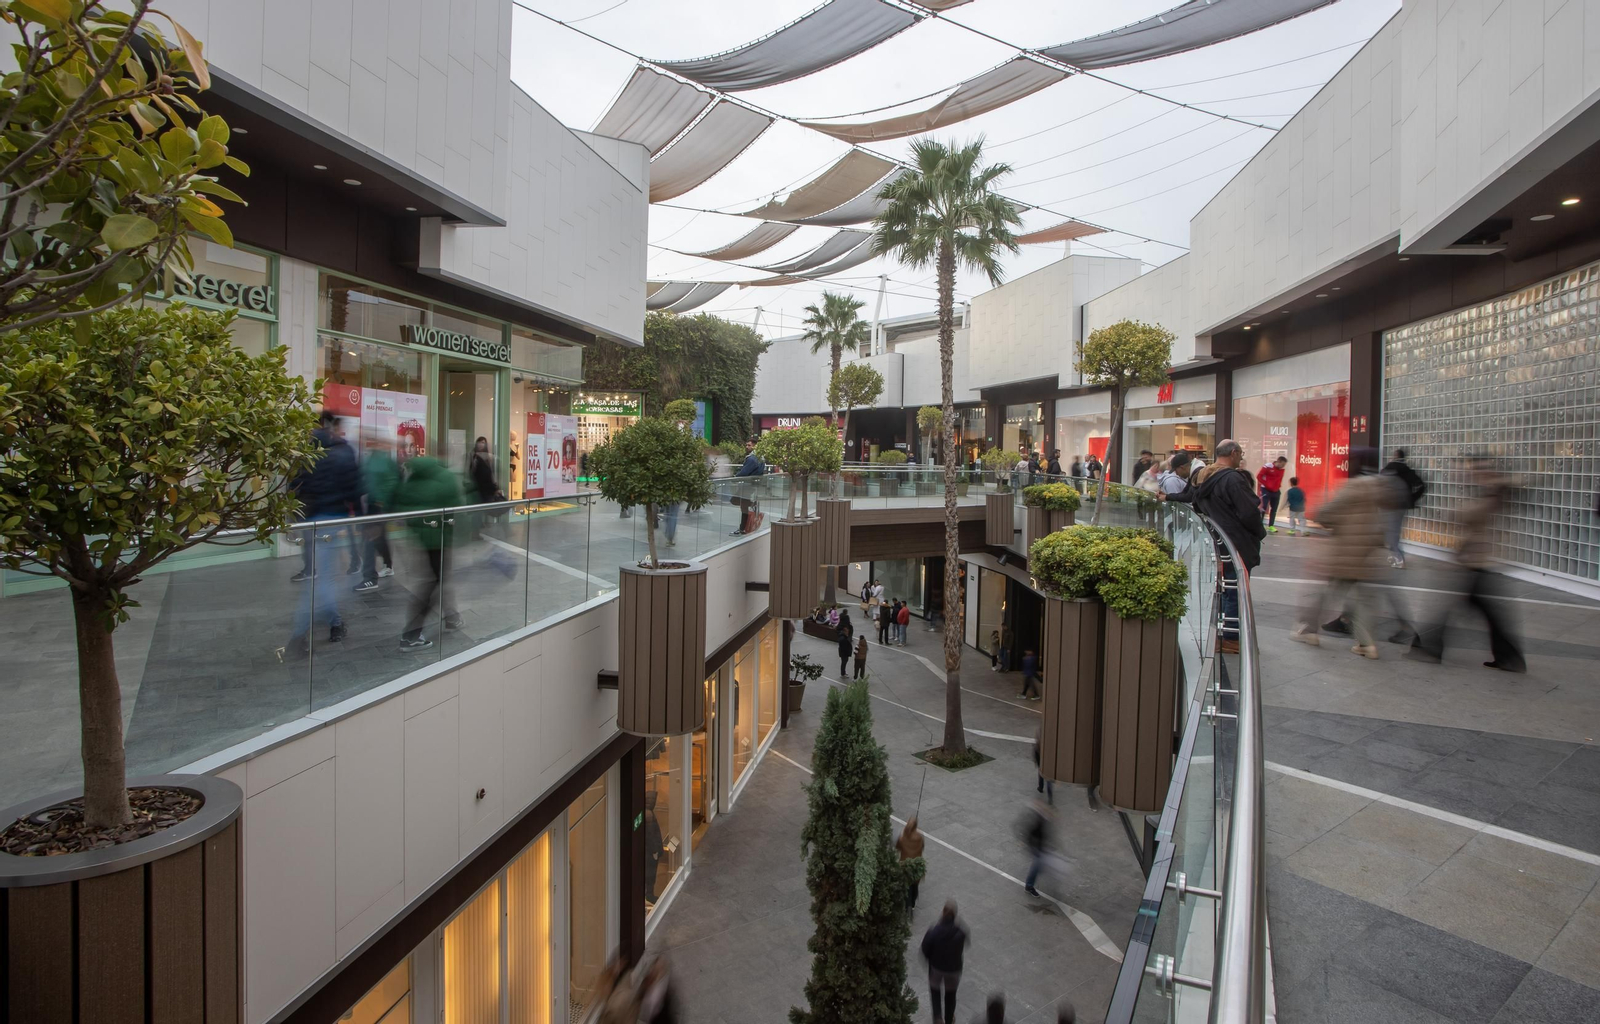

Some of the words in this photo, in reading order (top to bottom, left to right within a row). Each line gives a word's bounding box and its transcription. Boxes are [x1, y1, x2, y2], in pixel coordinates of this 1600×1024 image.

[413, 325, 511, 361] women'secret
[528, 445, 538, 457] RE
[528, 459, 541, 471] MA
[547, 450, 560, 470] 70
[1300, 454, 1322, 467] Rebajas
[528, 473, 538, 485] TE
